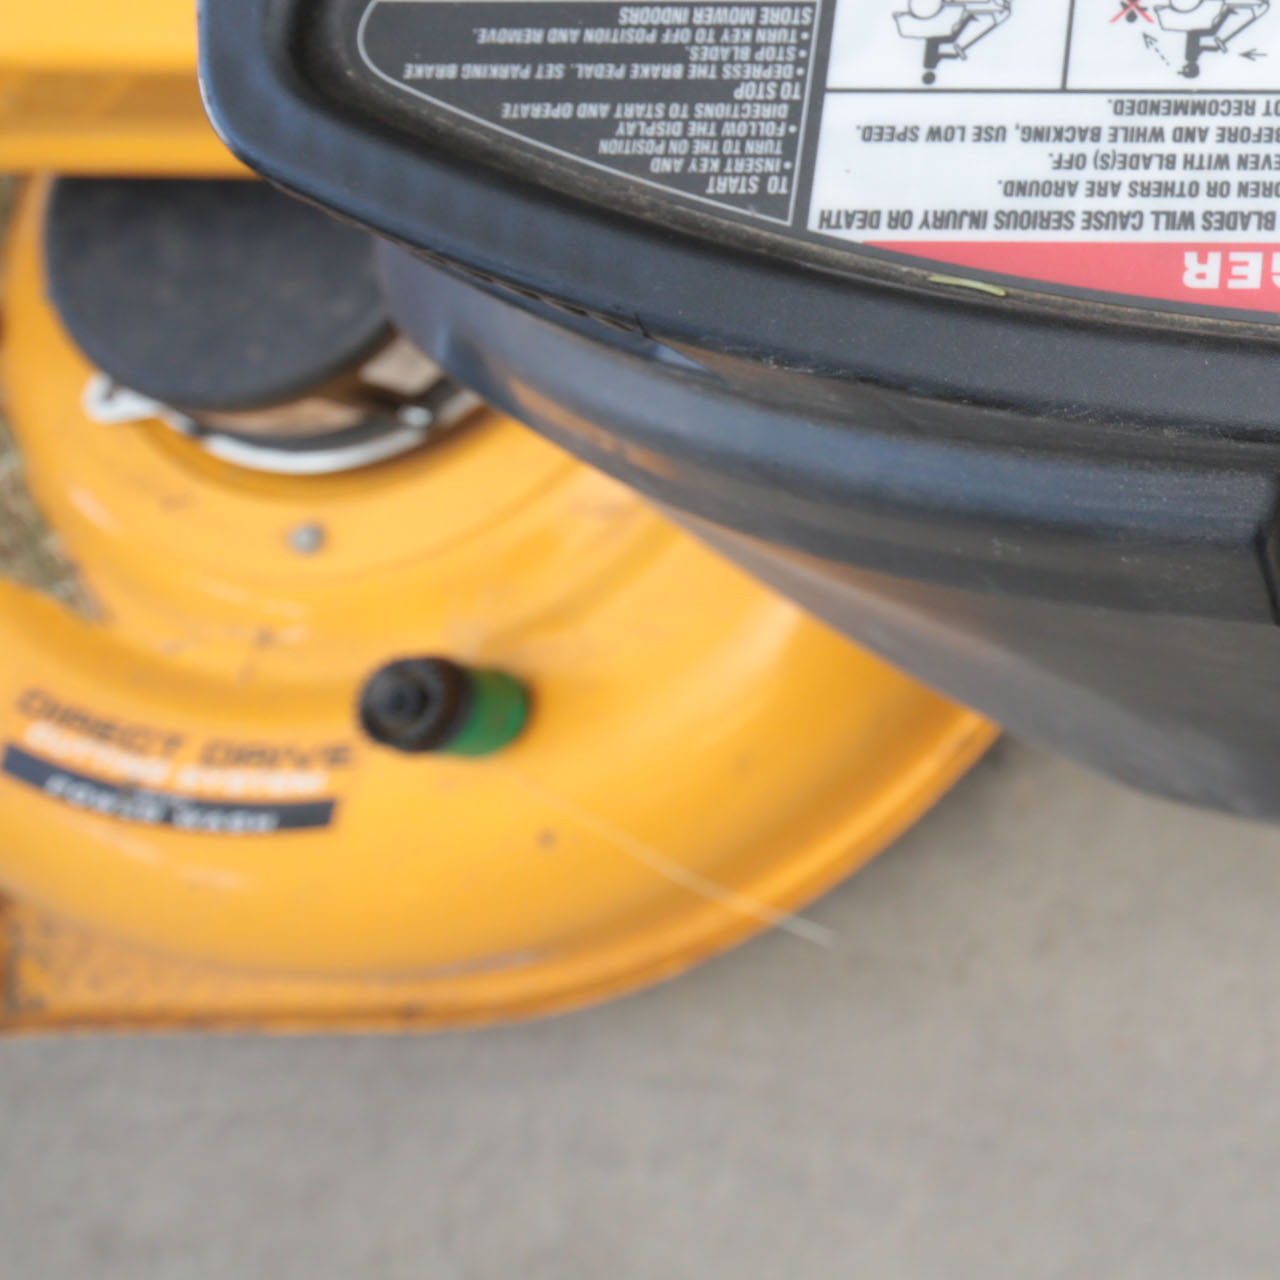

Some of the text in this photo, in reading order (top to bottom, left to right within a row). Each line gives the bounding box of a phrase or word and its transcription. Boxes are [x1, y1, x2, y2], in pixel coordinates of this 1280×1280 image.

[617, 6, 814, 26] STORE MOWER INDOORS
[685, 45, 798, 63] STOP BLADES.
[732, 80, 802, 101] TO STOP
[1107, 98, 1257, 117] RECOMMENDED.
[615, 120, 787, 138] FOLLOW THE DISPLAY
[856, 124, 921, 143] SPEED.
[924, 124, 967, 143] LOW
[971, 124, 1008, 144] USE
[1014, 124, 1103, 144] BACKING,
[1107, 125, 1166, 144] WHILE
[1171, 125, 1211, 144] AND
[649, 156, 783, 174] INSERT KEY AND
[1048, 152, 1088, 171] OFF.
[1092, 149, 1178, 171] BLADE(S)
[1181, 152, 1231, 172] WITH
[704, 174, 789, 195] TO START
[997, 179, 1080, 199] AROUND.
[1084, 179, 1123, 199] ARE
[1127, 179, 1201, 199] OTHERS
[1205, 180, 1232, 199] OR
[816, 209, 883, 231] DEATH
[885, 209, 915, 231] OR
[917, 209, 989, 231] INJURY
[992, 209, 1077, 231] SERIOUS
[1080, 209, 1145, 232] CAUSE
[1149, 209, 1197, 232] WILL
[1200, 210, 1277, 232] BLADES
